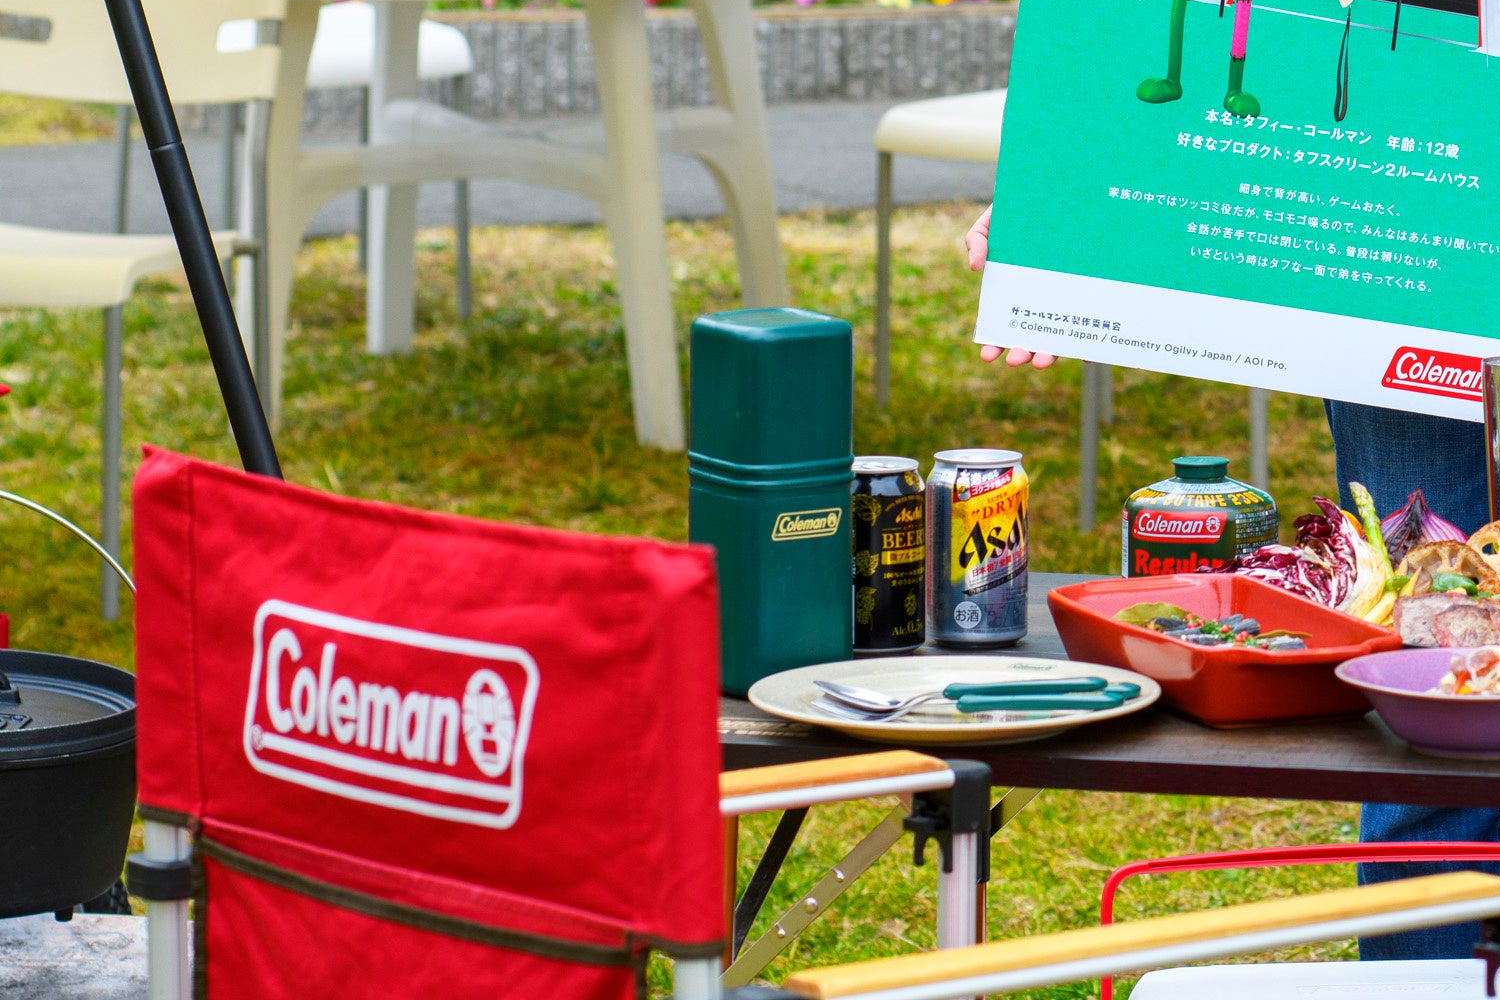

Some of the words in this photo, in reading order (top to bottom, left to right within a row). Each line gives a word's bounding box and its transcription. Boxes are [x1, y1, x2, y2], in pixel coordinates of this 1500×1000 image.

[1386, 134, 1460, 160] 年齢：12歳
[1238, 182, 1401, 217] 細身で背が高い、ゲームおたく。
[1020, 320, 1065, 336] Coleman
[1068, 328, 1099, 343] Japan
[1110, 335, 1161, 352] Geometry
[1164, 342, 1199, 358] Ogilvy
[1201, 348, 1233, 363] Japan
[1244, 356, 1264, 367] AOI
[1267, 358, 1288, 371] Pro.
[1395, 351, 1484, 391] Coleman
[1162, 493, 1228, 507] BUTANE
[778, 515, 827, 534] Coleman
[1138, 512, 1204, 533] Coleman
[954, 608, 980, 623] お酒
[266, 628, 460, 767] Coleman
